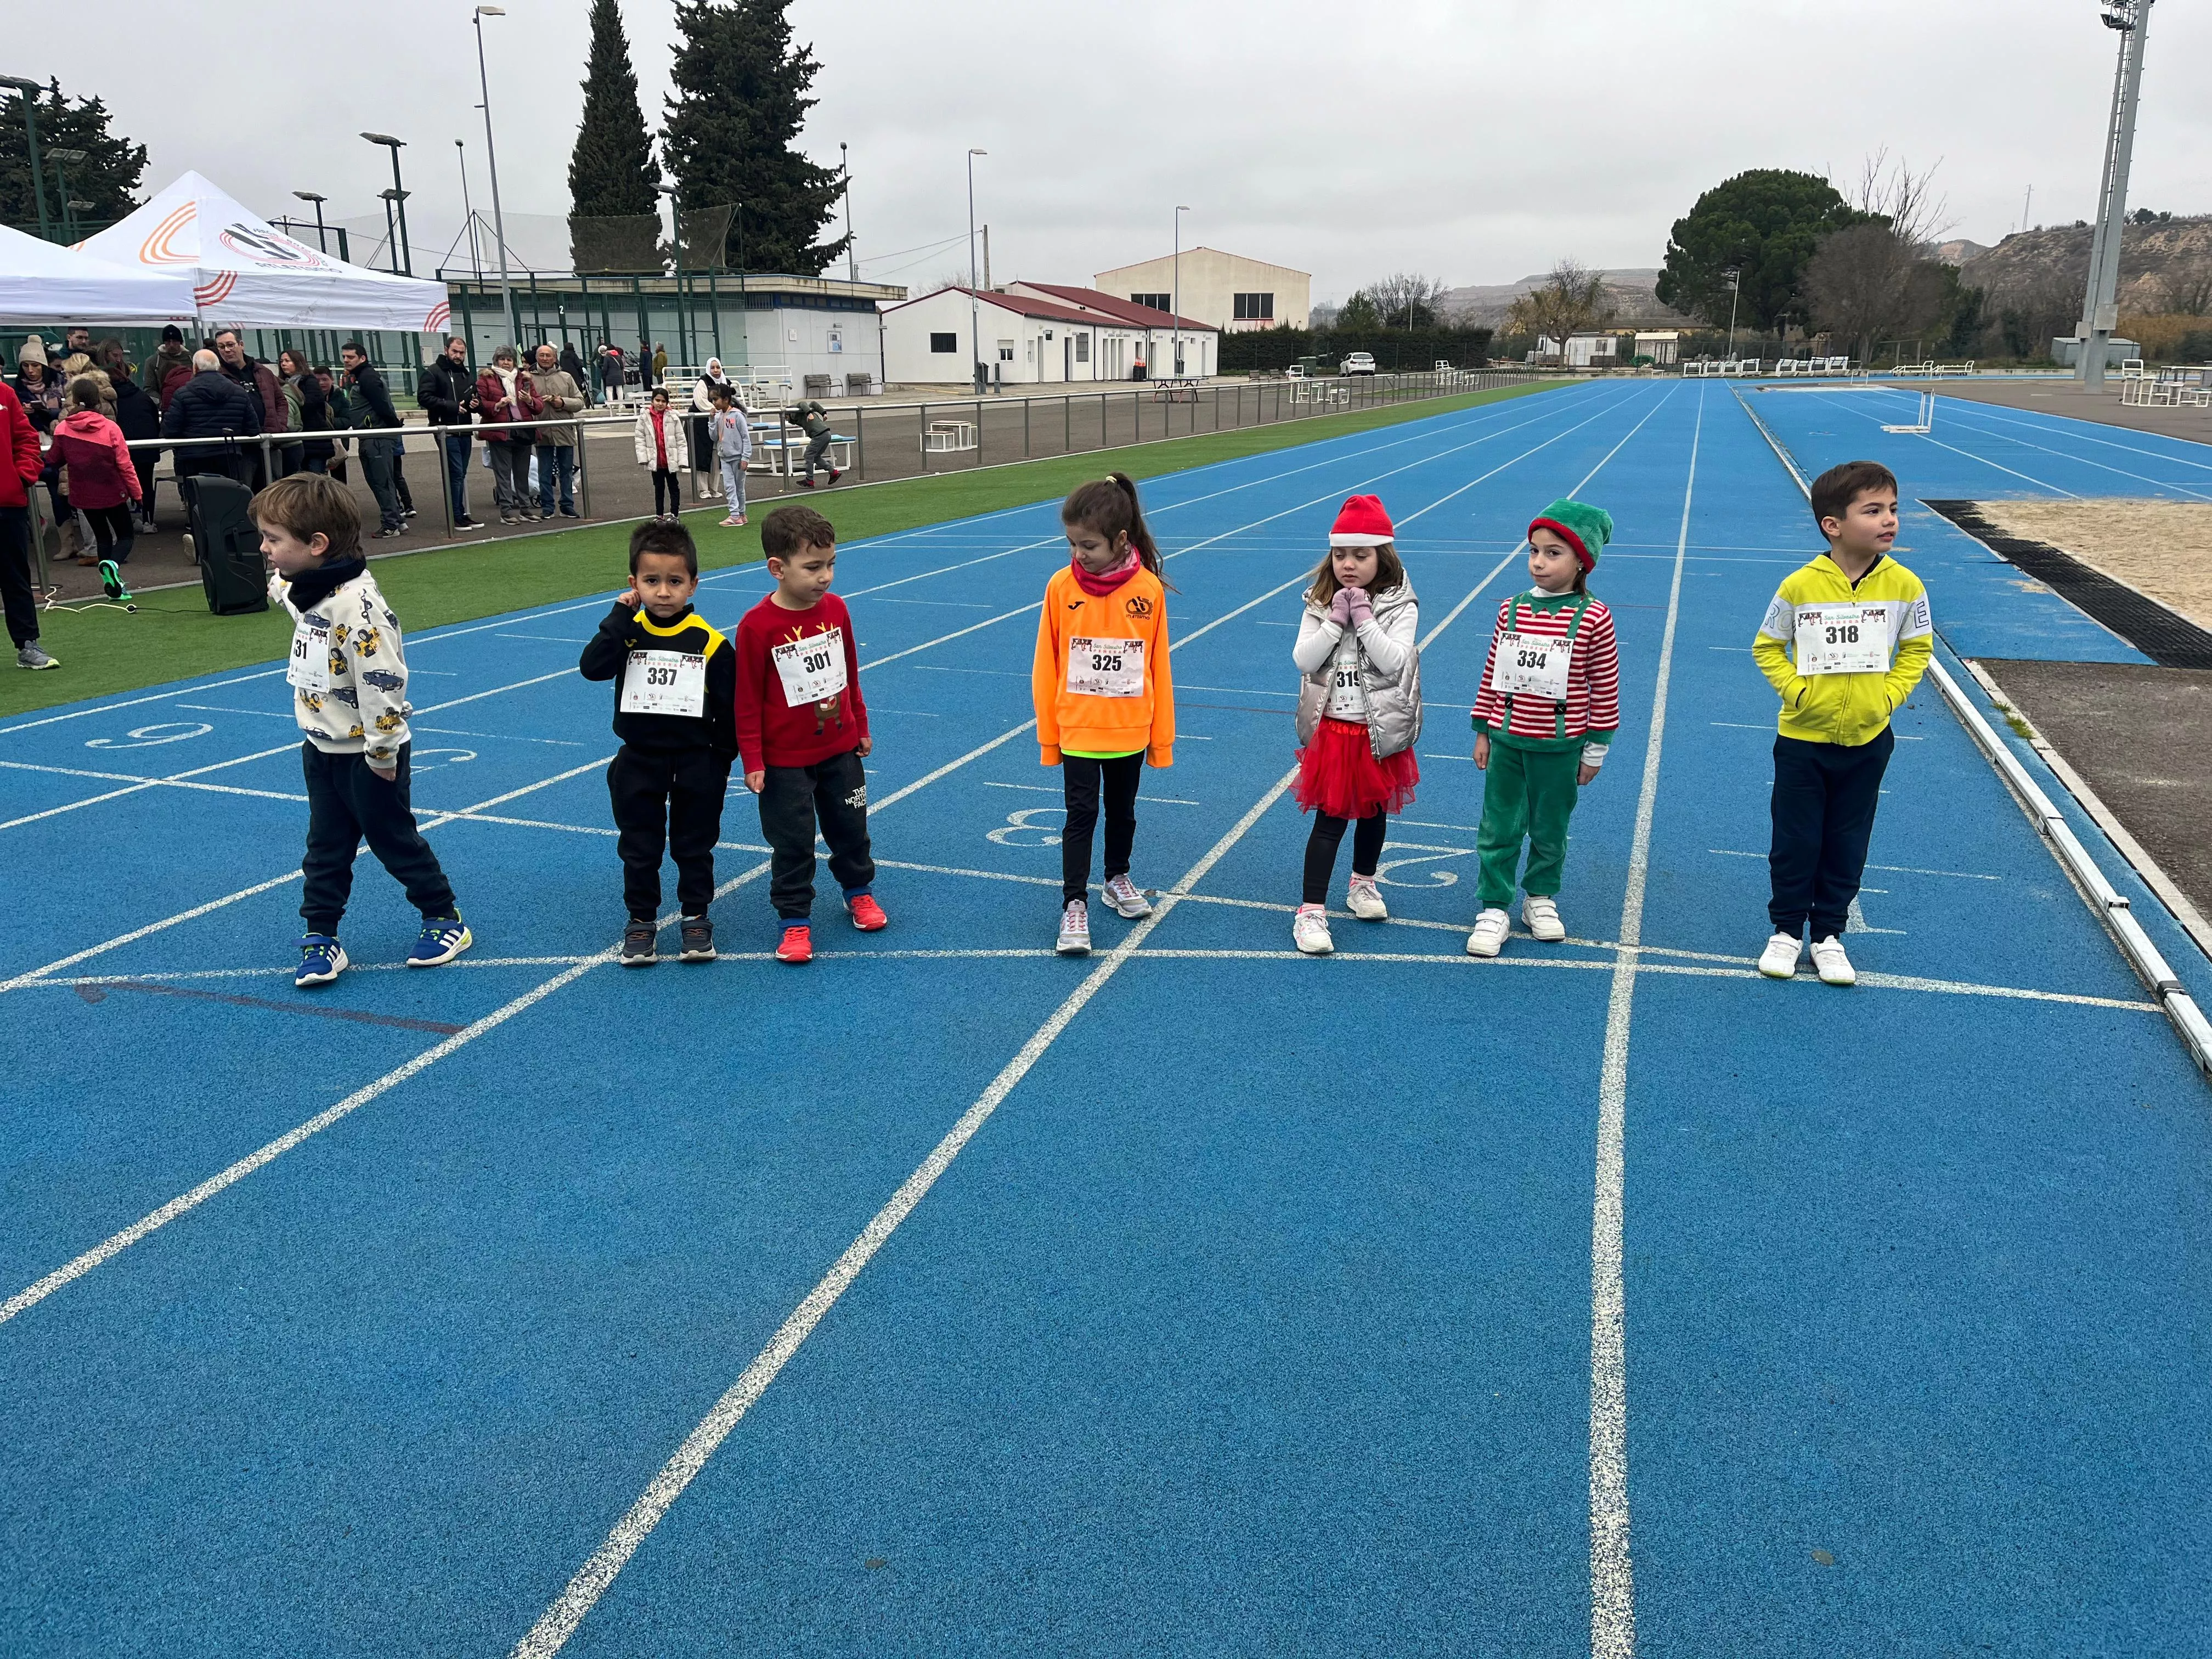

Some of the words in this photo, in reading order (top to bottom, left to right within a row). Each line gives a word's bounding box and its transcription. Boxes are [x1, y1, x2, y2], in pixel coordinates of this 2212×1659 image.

[559, 305, 564, 314] 2
[1826, 625, 1859, 644] 318
[294, 639, 307, 659] 31
[803, 650, 831, 673] 301
[1092, 654, 1122, 672] 325
[1517, 650, 1547, 669] 334
[647, 667, 678, 686] 337
